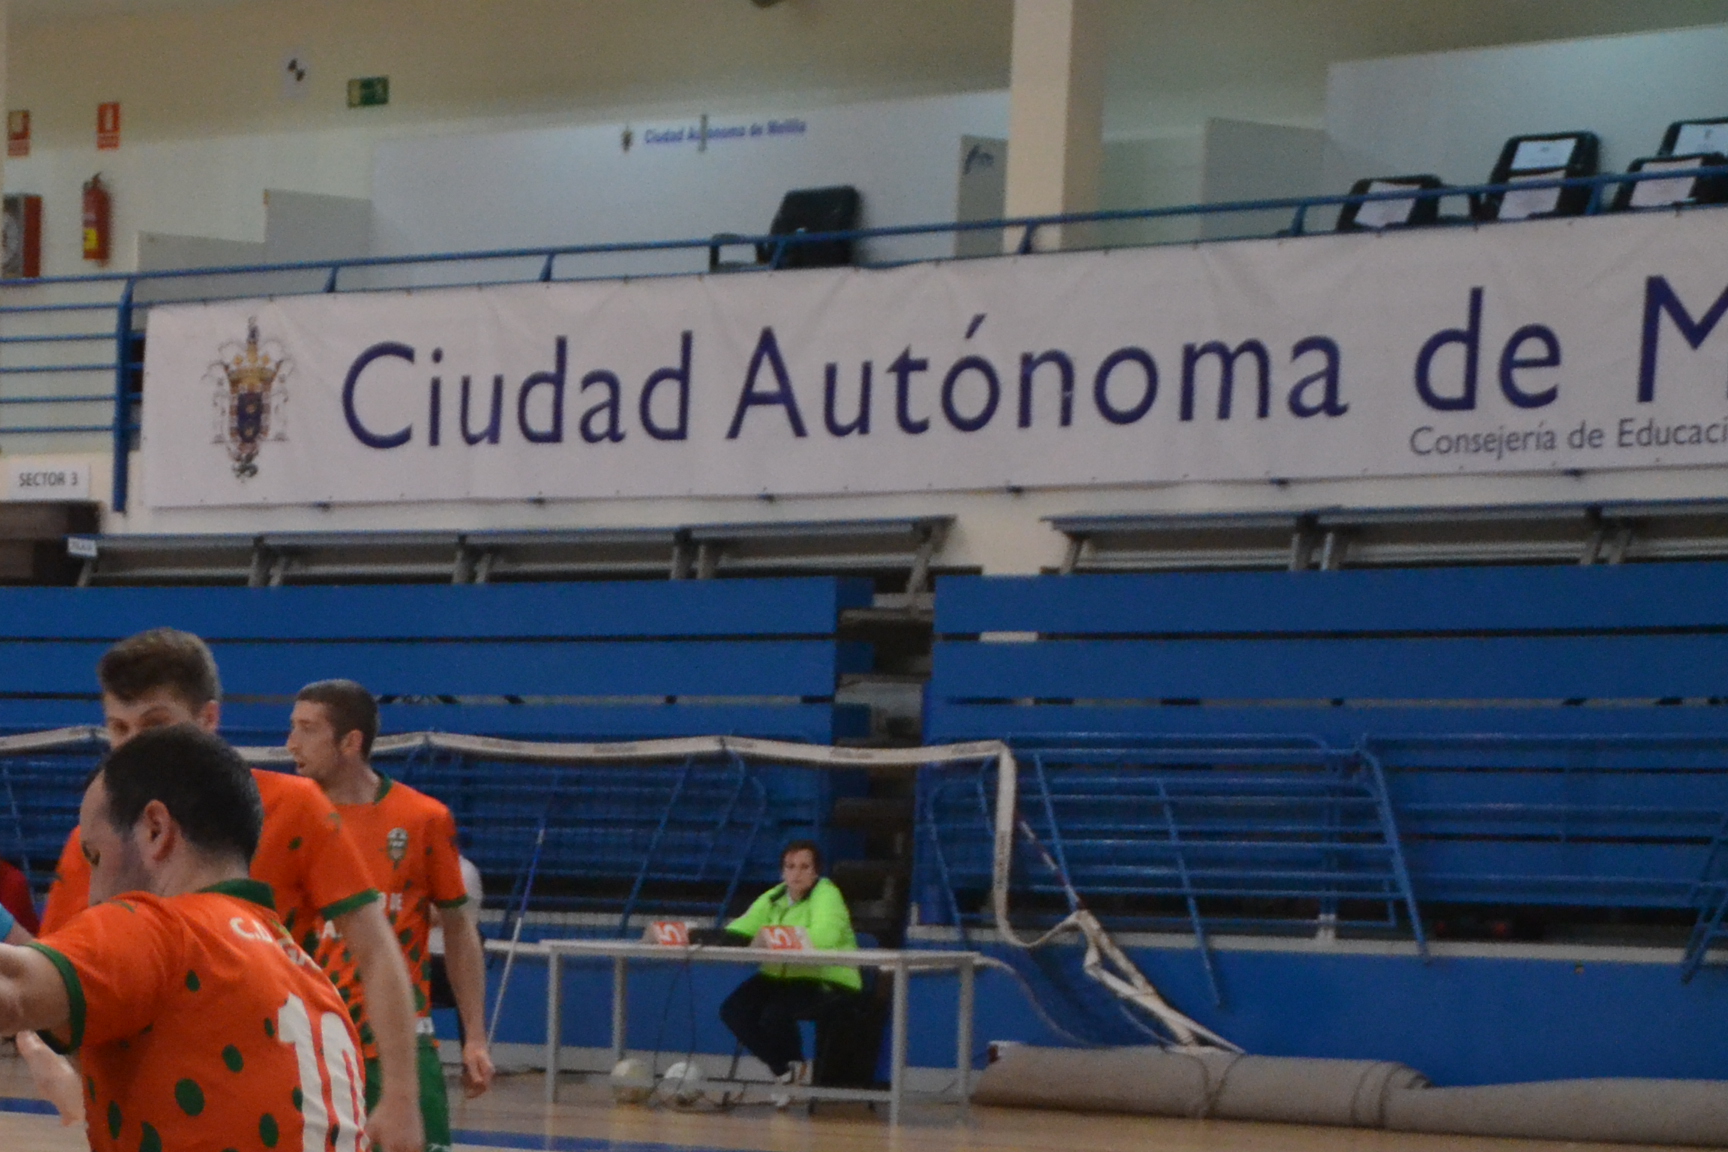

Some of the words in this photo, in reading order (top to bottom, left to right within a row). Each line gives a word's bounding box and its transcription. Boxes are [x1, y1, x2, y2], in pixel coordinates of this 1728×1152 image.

[342, 330, 694, 449] Ciudad
[725, 314, 1348, 440] Autónoma
[1413, 287, 1560, 411] de
[1636, 275, 1728, 403] M
[1409, 421, 1557, 460] Consejería
[1567, 420, 1605, 450] de
[1617, 415, 1728, 449] Educaci
[19, 472, 65, 487] SECTOR
[70, 472, 78, 485] 3
